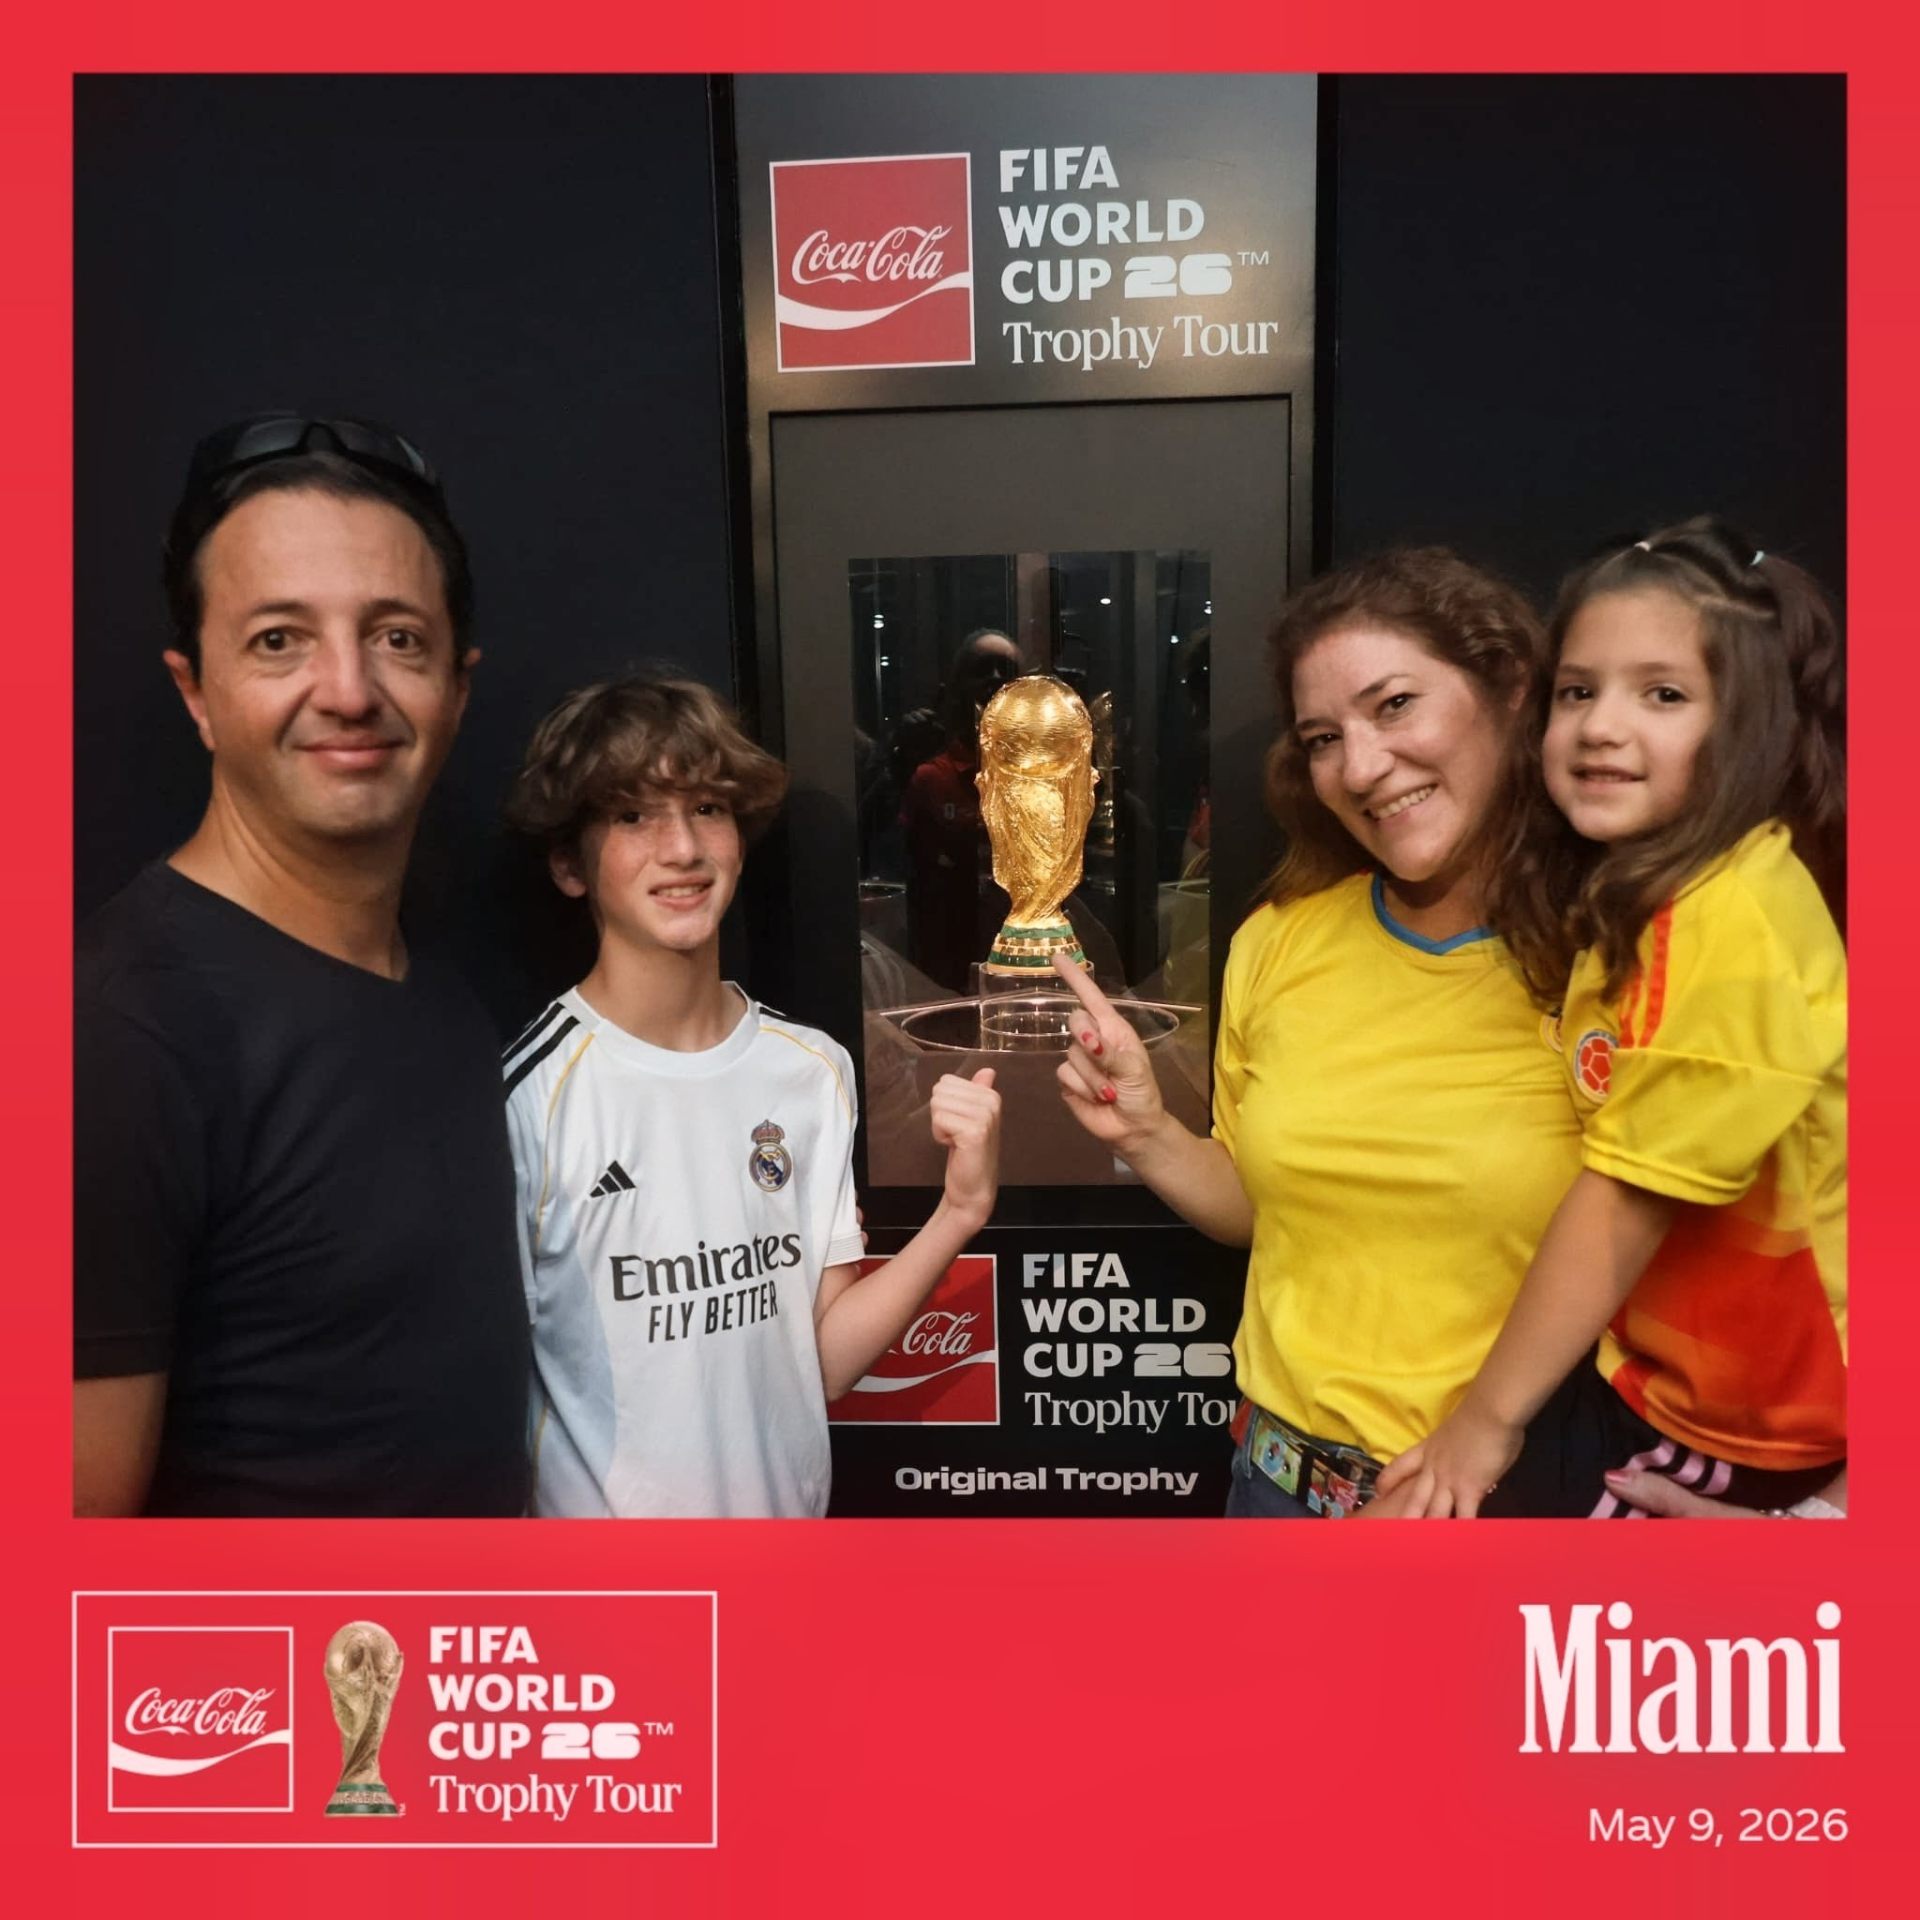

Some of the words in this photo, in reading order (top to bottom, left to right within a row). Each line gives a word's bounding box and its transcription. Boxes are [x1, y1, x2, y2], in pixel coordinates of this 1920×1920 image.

[1000, 146, 1119, 192] FIFA
[998, 198, 1205, 248] WORLD
[792, 226, 952, 284] Coca-Cola
[1001, 258, 1112, 304] CUP
[1003, 316, 1165, 371] Trophy
[1173, 314, 1278, 357] Tour
[608, 1233, 802, 1301] Emirates
[1023, 1254, 1131, 1288] FIFA
[648, 1301, 694, 1343] FLY
[704, 1280, 779, 1335] BETTER
[1021, 1298, 1206, 1333] WORLD
[1023, 1343, 1123, 1378] CUP
[1134, 1343, 1231, 1377] 26
[1025, 1391, 1170, 1434] Trophy
[895, 1467, 1047, 1496] Original
[1055, 1468, 1199, 1496] Trophy
